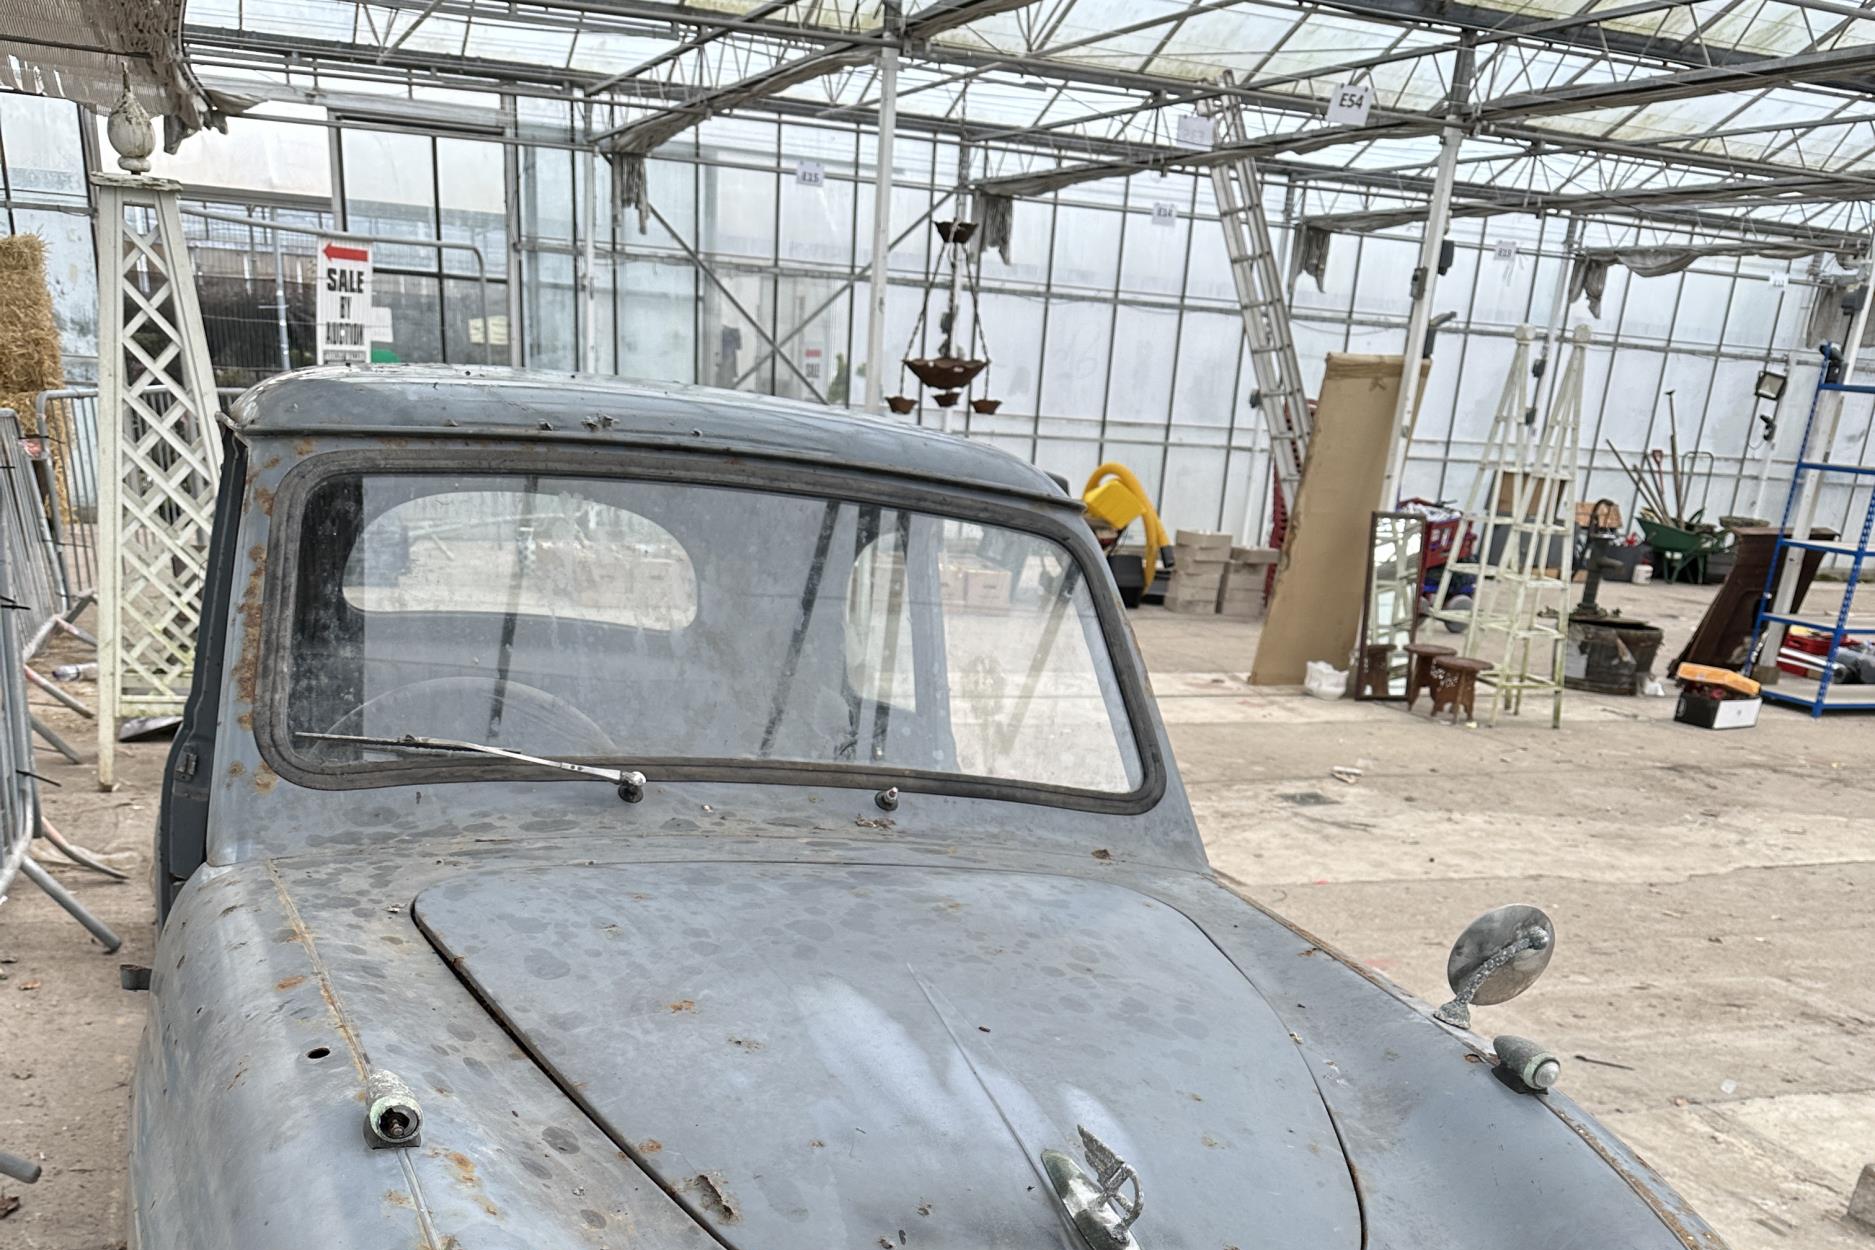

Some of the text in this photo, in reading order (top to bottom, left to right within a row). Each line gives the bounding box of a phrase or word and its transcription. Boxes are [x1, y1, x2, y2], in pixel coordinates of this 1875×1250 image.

[1339, 92, 1364, 109] E54
[327, 268, 364, 293] SALE
[340, 296, 352, 319] BY
